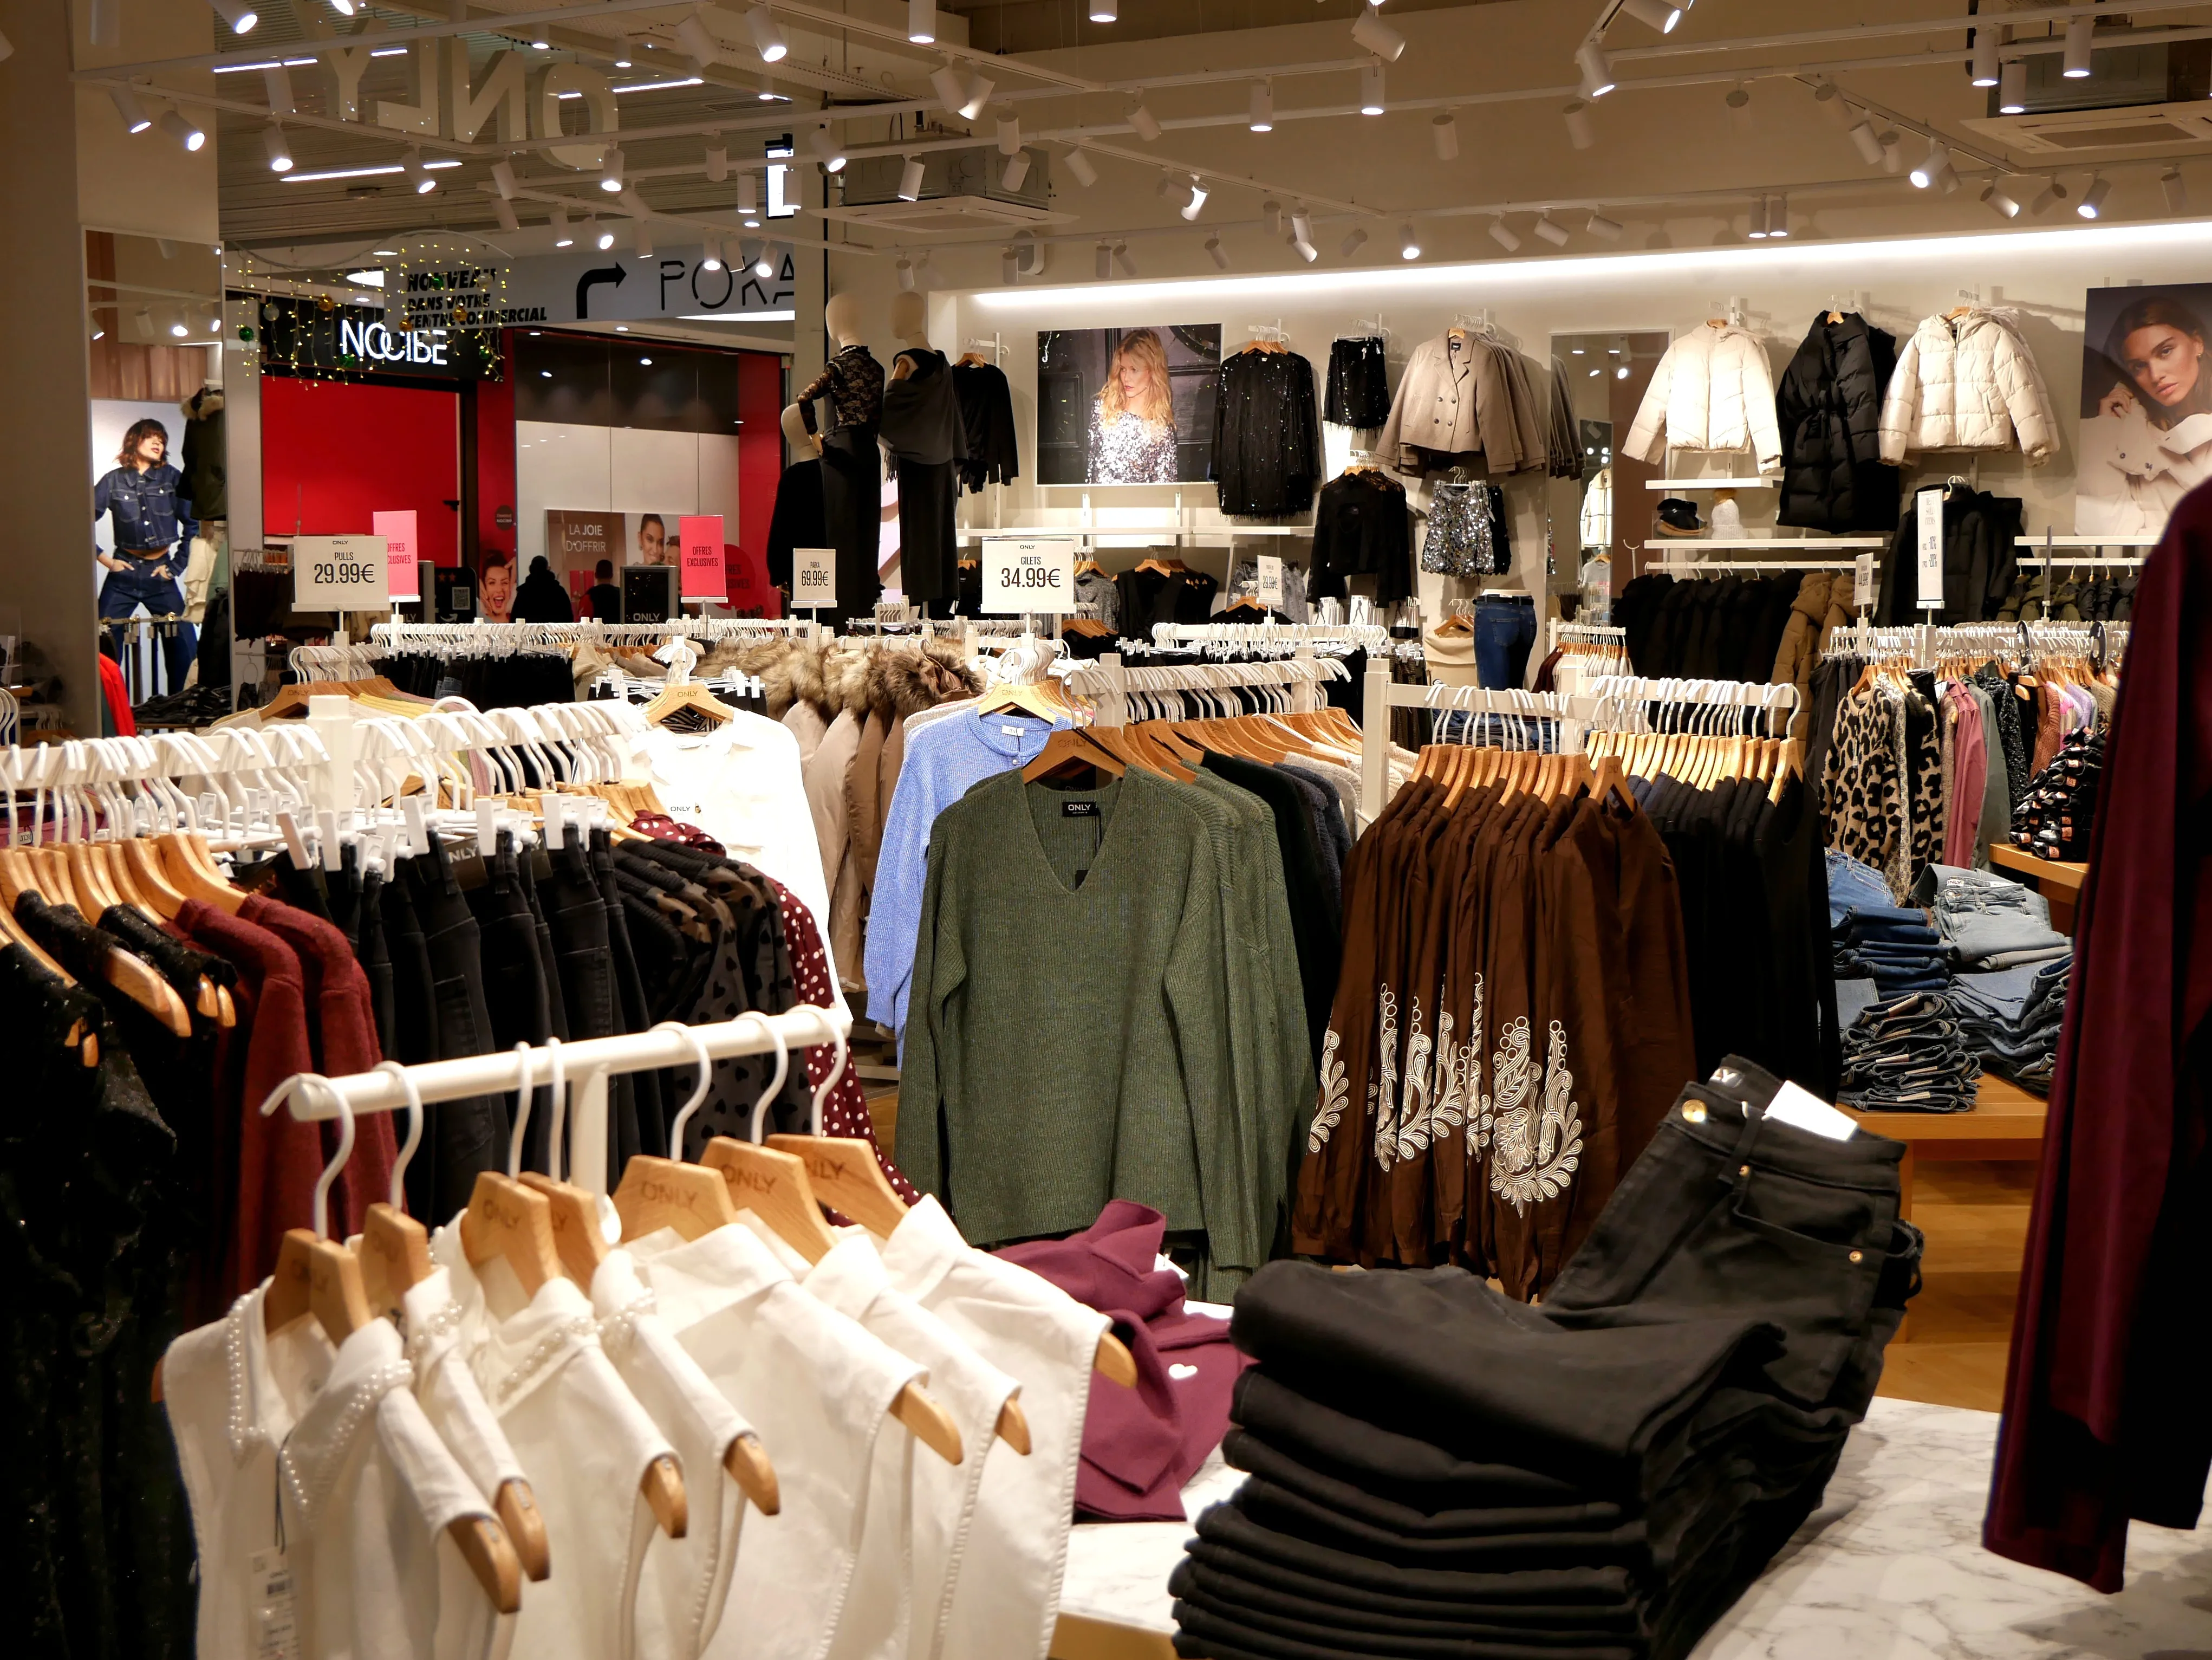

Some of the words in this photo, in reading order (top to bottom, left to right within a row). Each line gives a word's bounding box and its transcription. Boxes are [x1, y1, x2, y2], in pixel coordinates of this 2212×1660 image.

[407, 268, 496, 292] NOVEA
[407, 296, 443, 312] DANS
[446, 294, 490, 309] VOTRE
[569, 524, 581, 535] LA
[582, 524, 603, 536] JOIE
[566, 540, 606, 552] D'OFFRIR
[692, 546, 712, 555] OFFRES
[334, 552, 354, 561] PULLS
[388, 555, 411, 565] CLUSIVES
[687, 557, 718, 567] EXCLUSIVES
[1021, 556, 1041, 565] GILETS
[314, 563, 375, 583] 29.99€
[802, 570, 829, 586] 69.99€
[1001, 568, 1061, 588] 34.99€
[404, 613, 417, 622] LY
[633, 613, 660, 621] ONLY
[447, 845, 478, 863] NLY
[1709, 1068, 1738, 1082] LY
[806, 1160, 847, 1180] NLY
[719, 1164, 777, 1194] ONLY
[641, 1181, 698, 1209] ONLY
